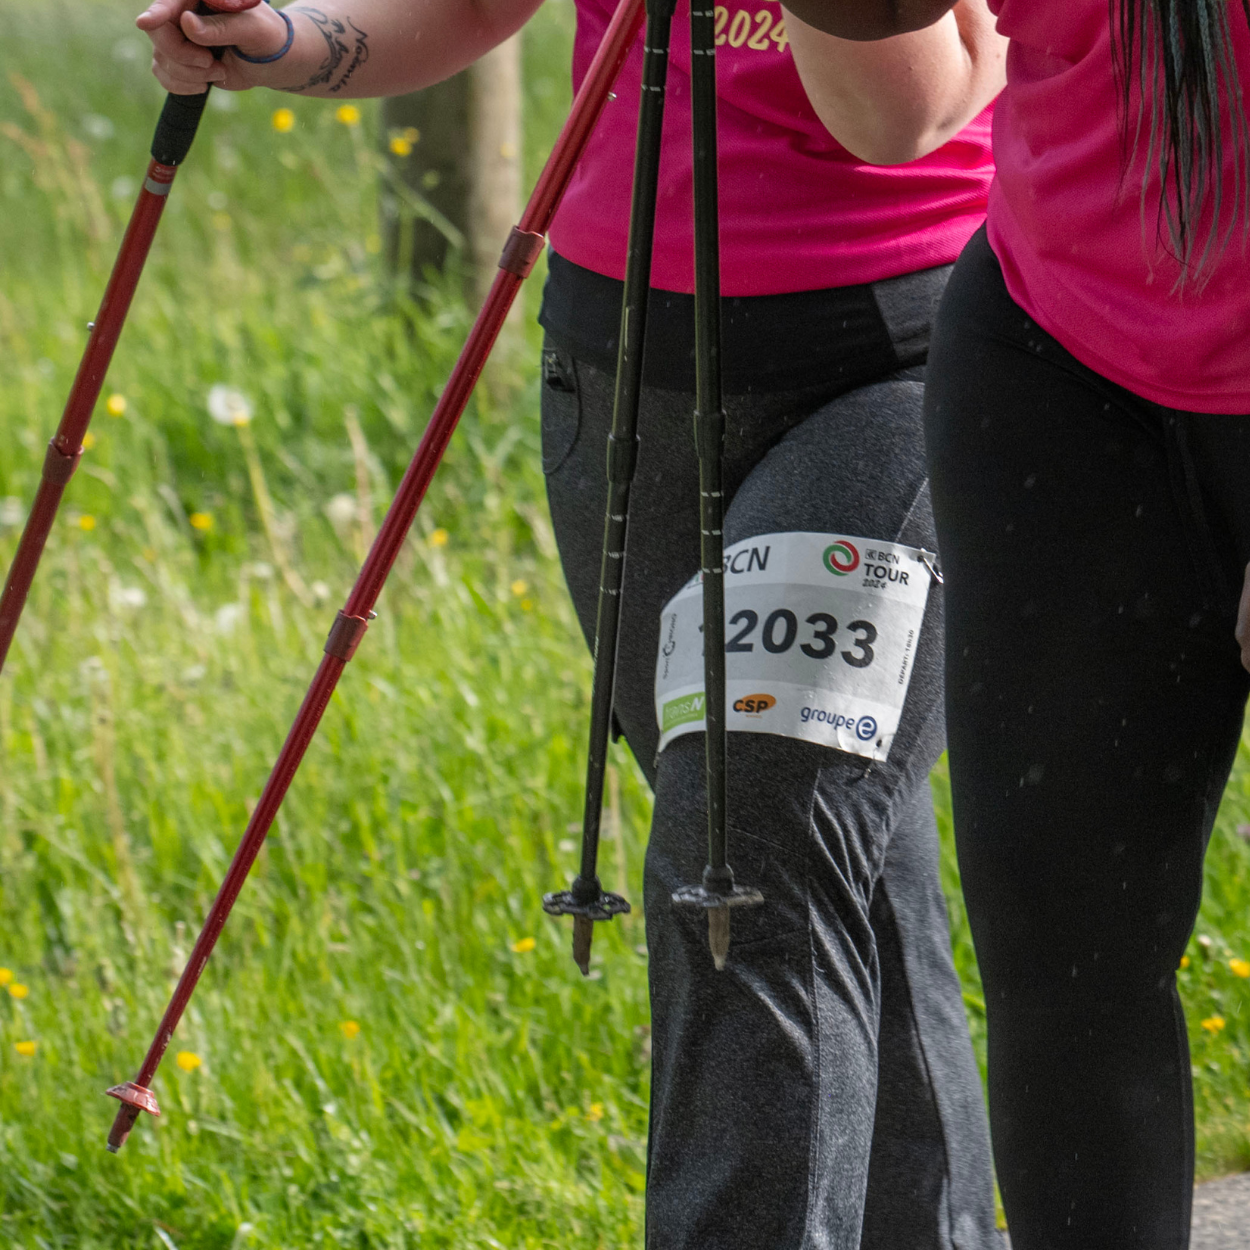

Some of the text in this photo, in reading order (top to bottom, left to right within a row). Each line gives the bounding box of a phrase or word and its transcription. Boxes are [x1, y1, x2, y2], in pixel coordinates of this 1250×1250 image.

[714, 6, 790, 52] 2024
[878, 552, 900, 564] BCN
[864, 563, 909, 585] TOUR
[698, 609, 877, 668] 2033
[733, 699, 768, 714] CSP
[800, 706, 855, 730] groupe
